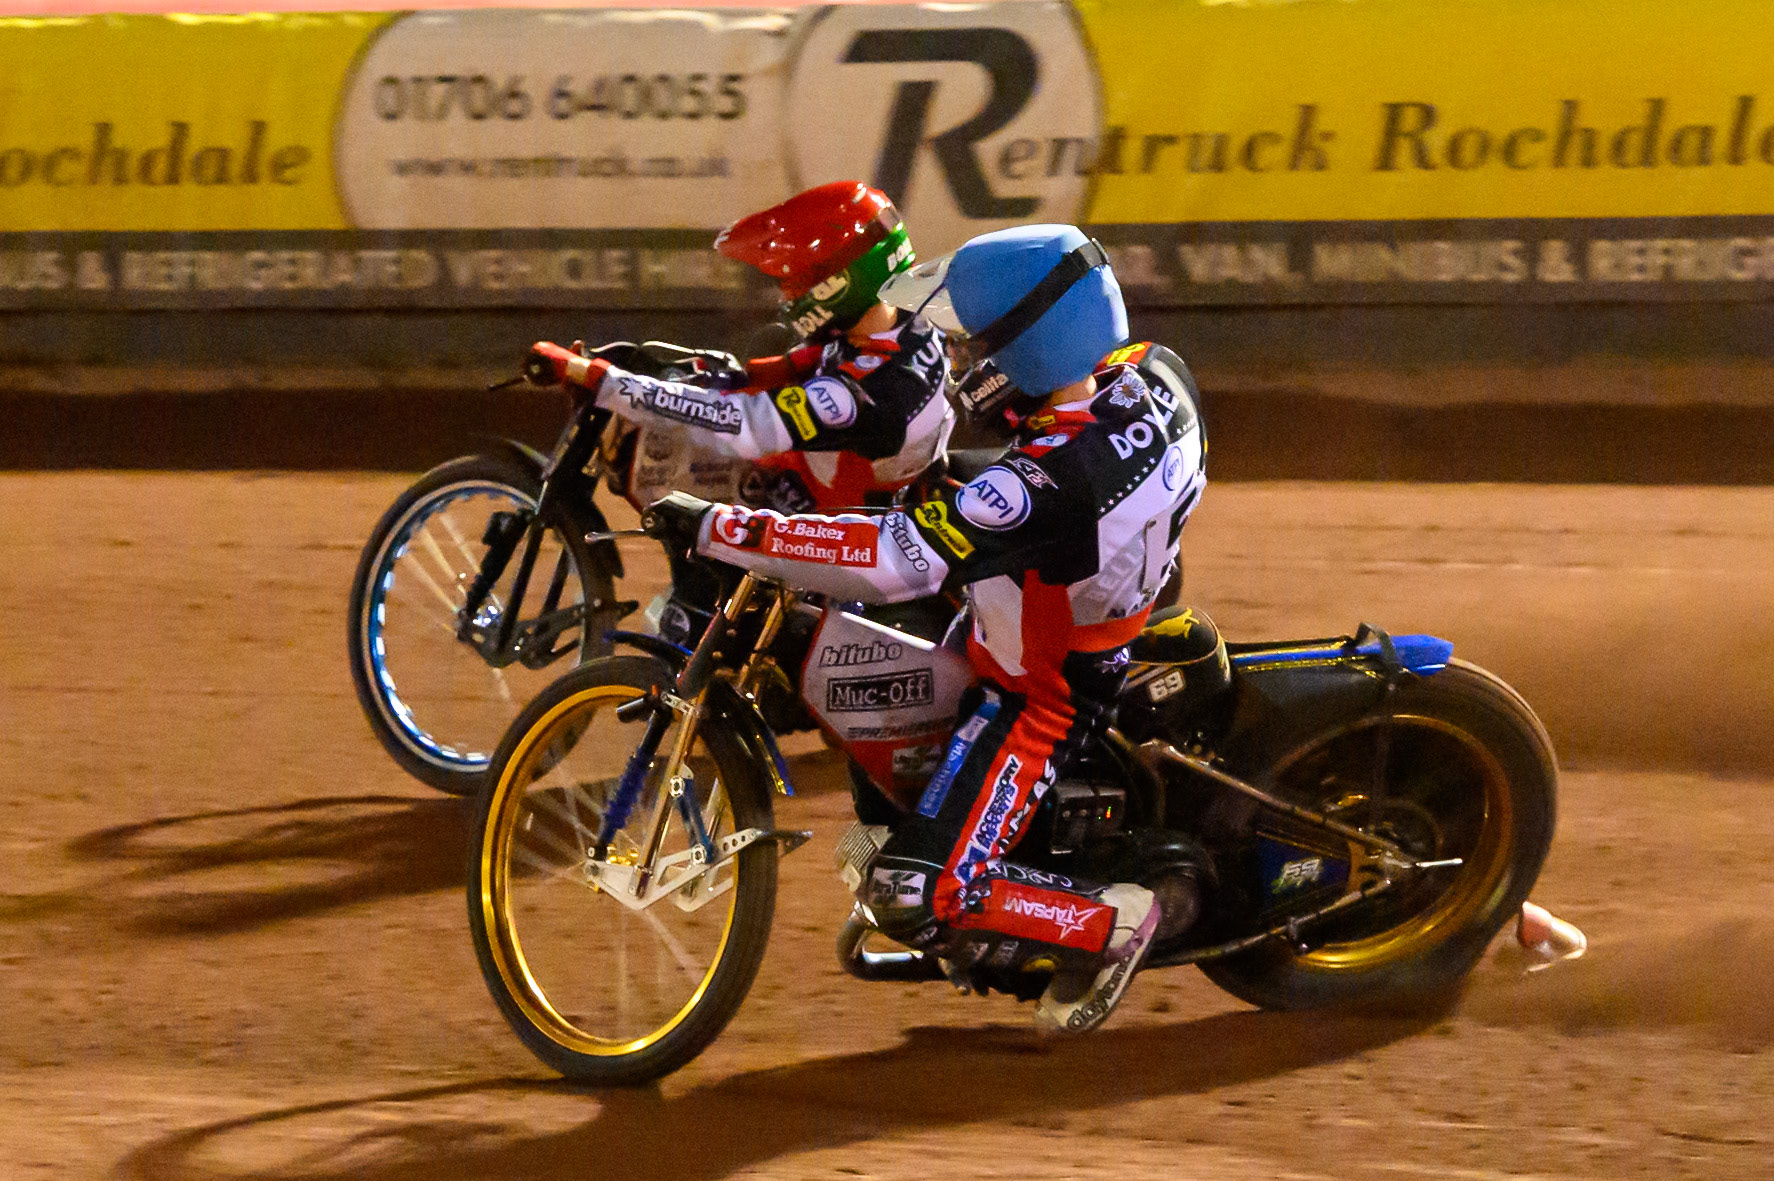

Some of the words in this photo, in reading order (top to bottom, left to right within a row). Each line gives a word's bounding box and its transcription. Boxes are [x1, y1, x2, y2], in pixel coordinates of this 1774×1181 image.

[373, 73, 532, 121] 01706
[547, 73, 748, 121] 640055
[0, 120, 311, 187] ochdale
[653, 387, 743, 427] burnside
[811, 387, 843, 420] ATPI
[1108, 385, 1180, 460] DOYLE
[969, 479, 1014, 519] ATPI
[771, 537, 838, 564] Roofing
[841, 545, 872, 563] Ltd
[819, 641, 902, 667] bitubo
[835, 680, 928, 706] Muc-Off
[1149, 670, 1184, 702] 69
